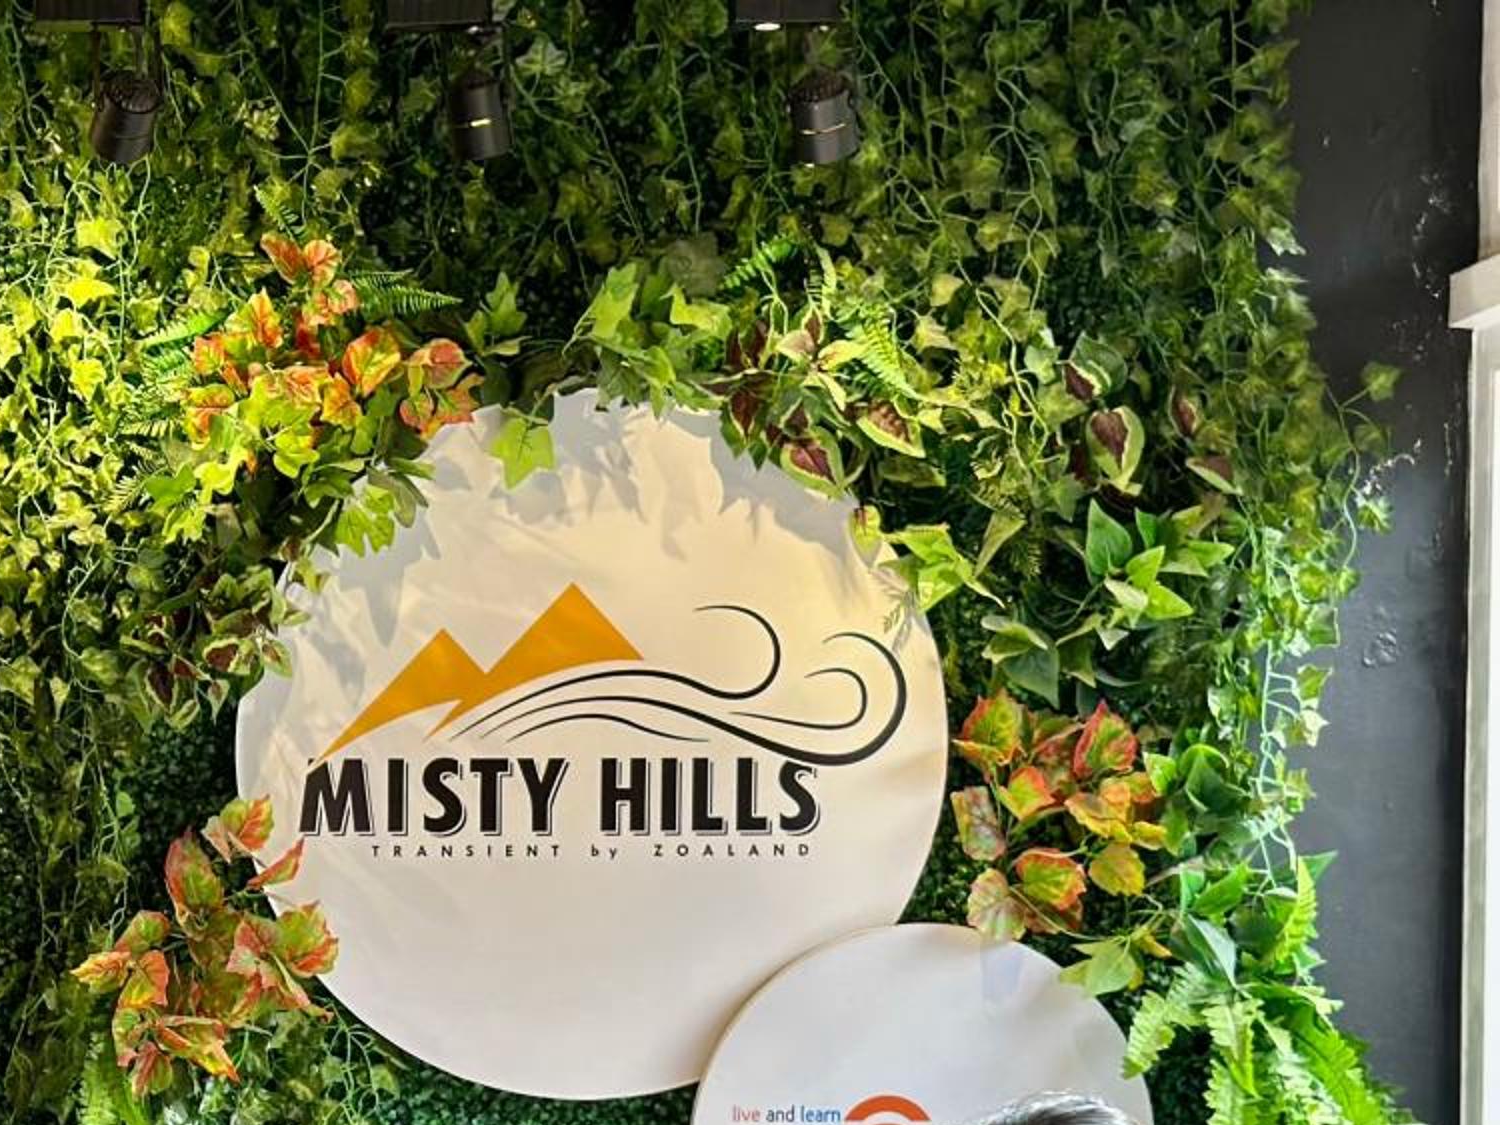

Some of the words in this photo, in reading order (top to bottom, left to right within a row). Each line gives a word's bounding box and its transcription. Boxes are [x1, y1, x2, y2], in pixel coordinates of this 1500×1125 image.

[299, 757, 571, 837] MISTY
[599, 757, 821, 837] HILLS
[371, 844, 562, 858] TRANSIENT
[590, 844, 618, 861] by
[653, 844, 811, 858] ZOALAND
[732, 1104, 762, 1123] live
[765, 1104, 796, 1123] and
[800, 1104, 842, 1123] learn
